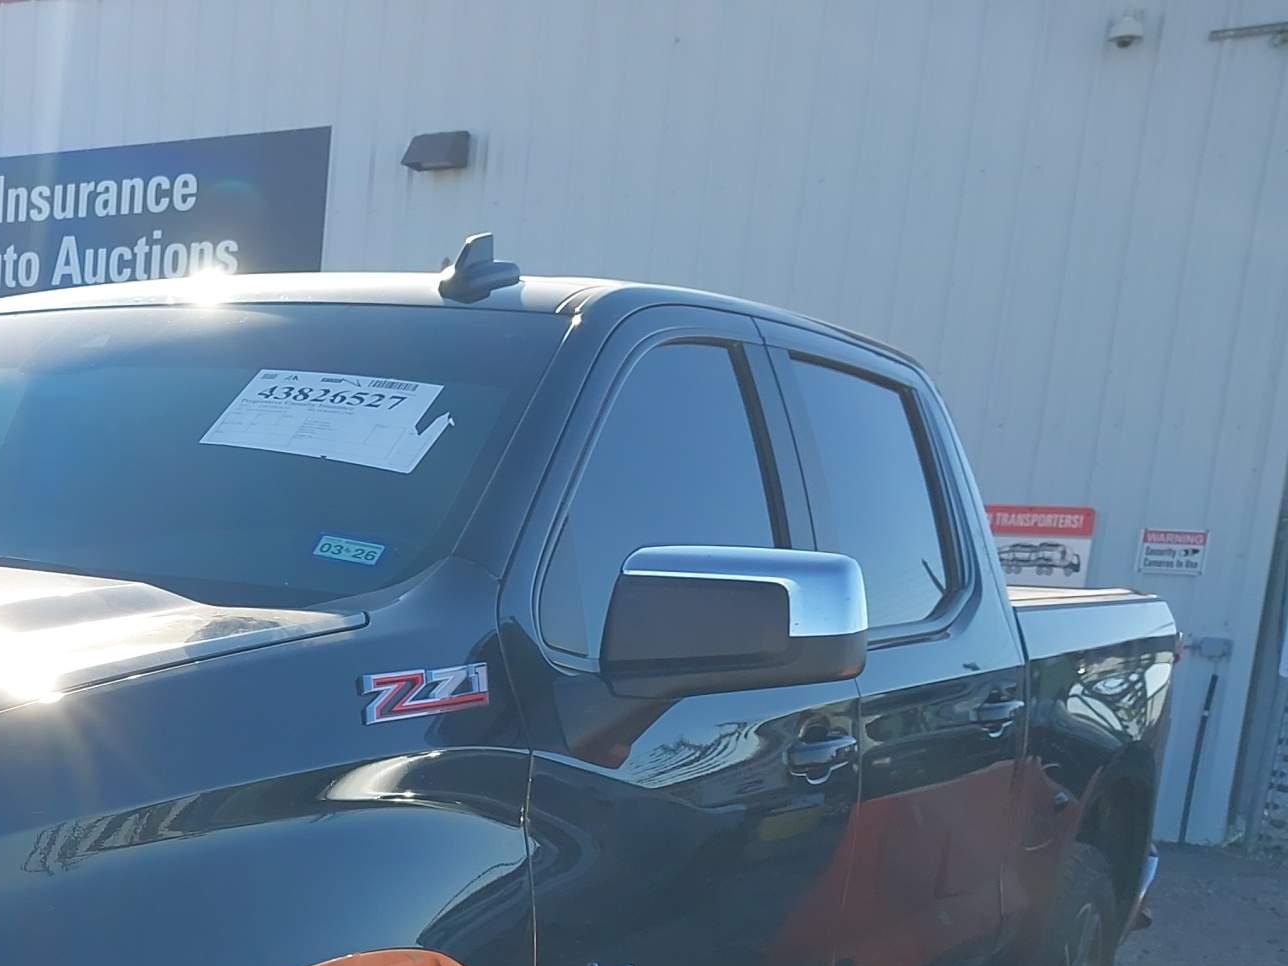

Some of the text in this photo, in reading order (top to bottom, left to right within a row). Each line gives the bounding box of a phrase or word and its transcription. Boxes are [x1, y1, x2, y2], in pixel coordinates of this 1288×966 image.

[52, 230, 239, 286] Auctions
[257, 385, 408, 410] 43826527
[995, 511, 1085, 529] TRANSPORTERS!
[1146, 532, 1205, 545] WARNING
[361, 662, 489, 725] Z71
